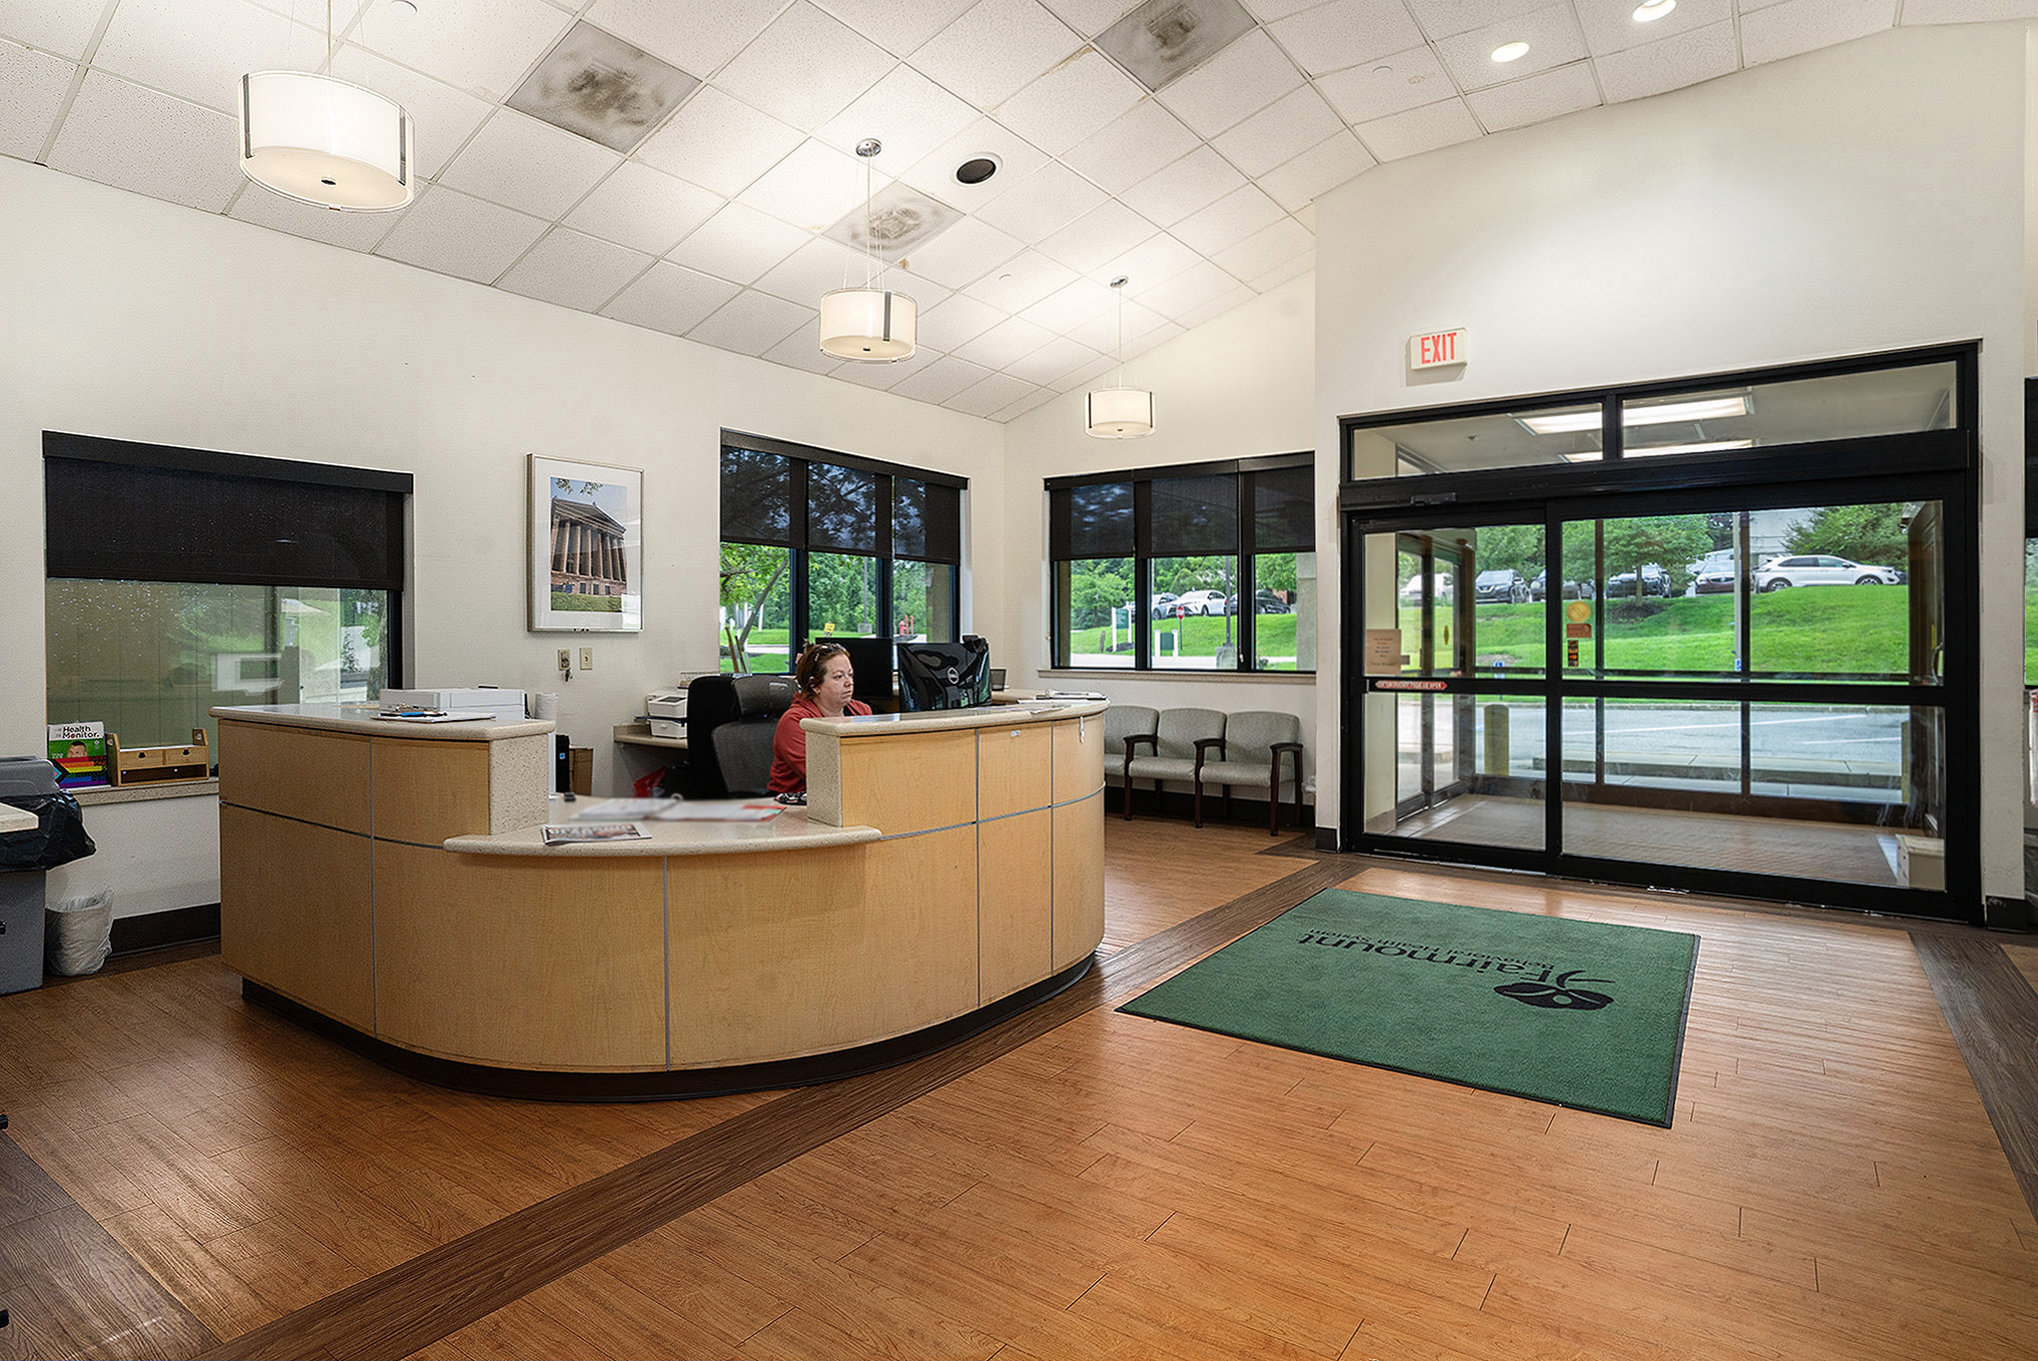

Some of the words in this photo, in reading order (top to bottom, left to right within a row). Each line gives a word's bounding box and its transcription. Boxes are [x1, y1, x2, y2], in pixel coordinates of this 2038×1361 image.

[1420, 332, 1457, 364] EXIT
[63, 725, 91, 733] Health
[1299, 934, 1555, 982] Fairmount
